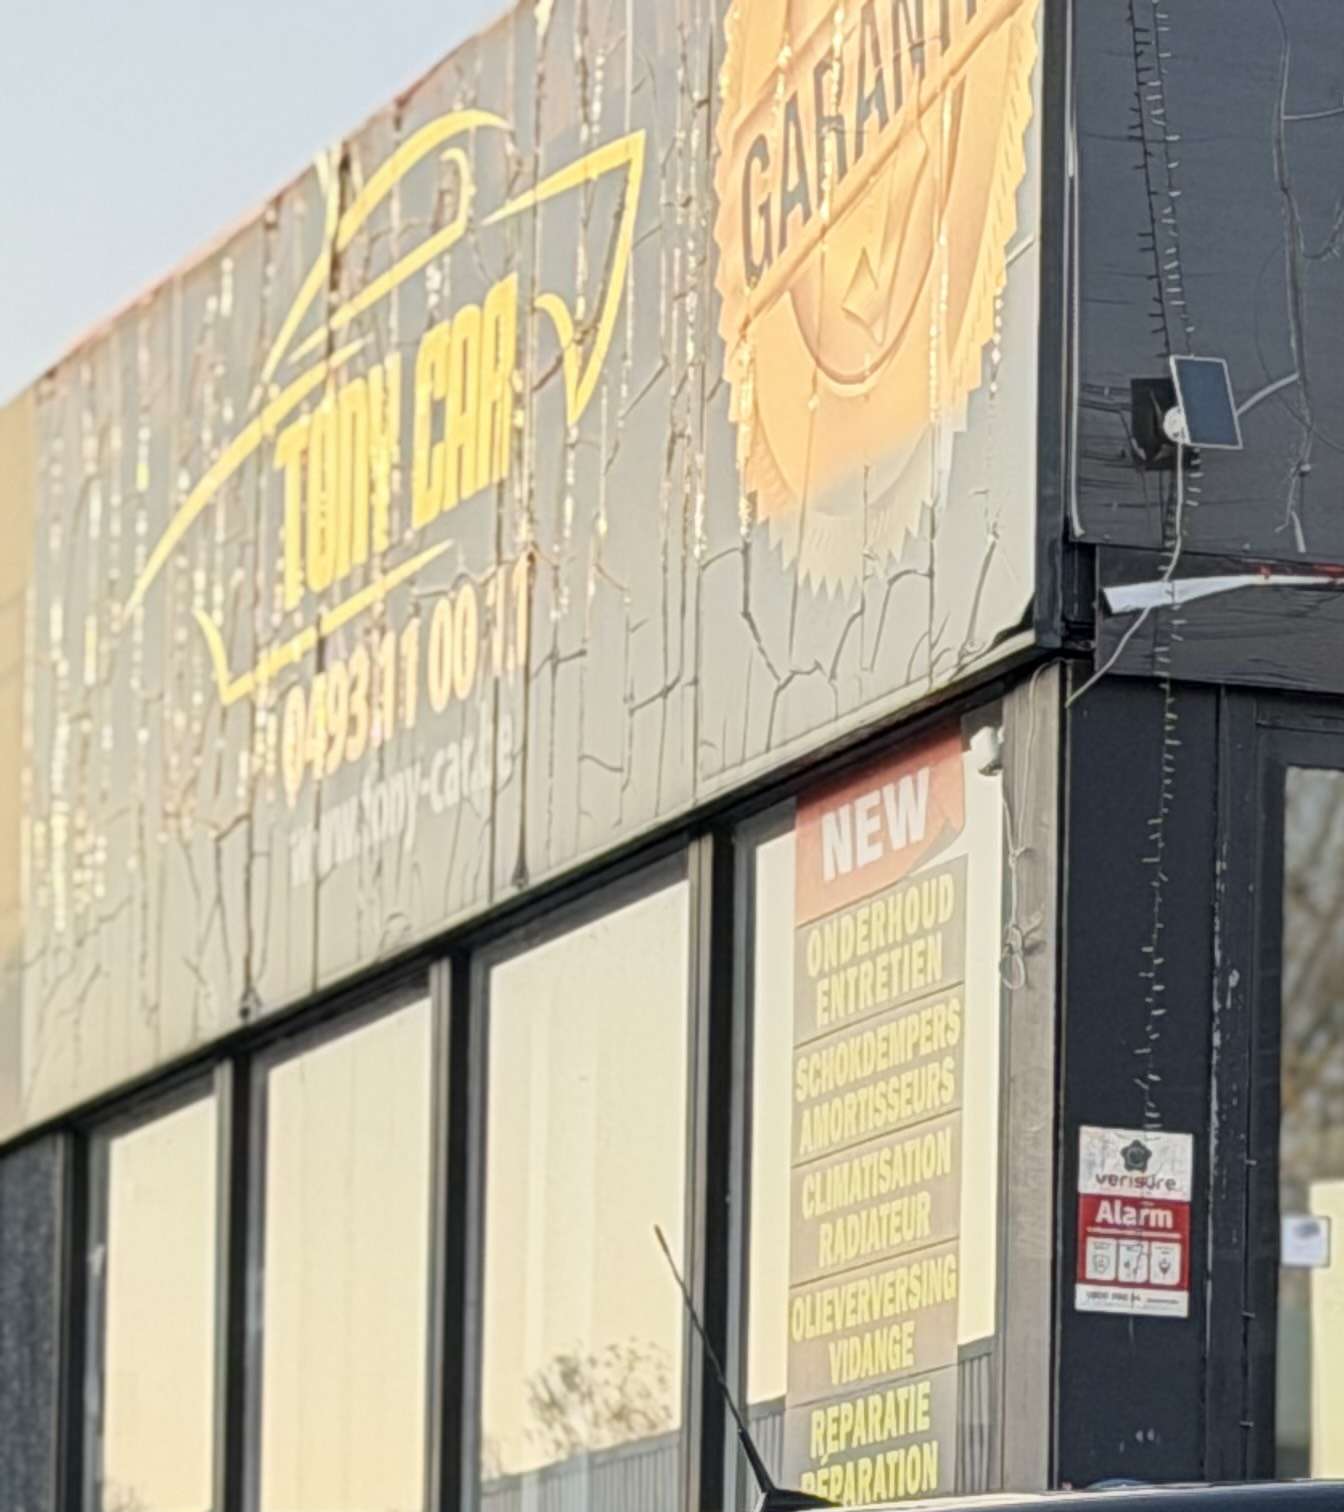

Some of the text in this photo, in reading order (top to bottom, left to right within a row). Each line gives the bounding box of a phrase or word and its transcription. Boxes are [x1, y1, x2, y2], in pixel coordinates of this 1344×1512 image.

[742, 0, 977, 290] GARAN
[412, 271, 518, 530] CAR
[428, 582, 477, 713] 00
[821, 766, 931, 881] NEW
[808, 873, 955, 978] ONDERHOUD
[816, 931, 942, 1030] ENTRETIEN
[796, 997, 961, 1102] SCHOKDEMPERS
[800, 1056, 955, 1155] AMORTISSEURS
[801, 1127, 951, 1220] CLIMATISATION
[1094, 1171, 1178, 1192] verisure
[1096, 1200, 1173, 1229] Alarm
[819, 1191, 931, 1268] RADIATEUR
[792, 1254, 957, 1343] OLIEVERVERSING
[829, 1321, 915, 1386] VIDANGE
[811, 1381, 931, 1459] REPARATIE
